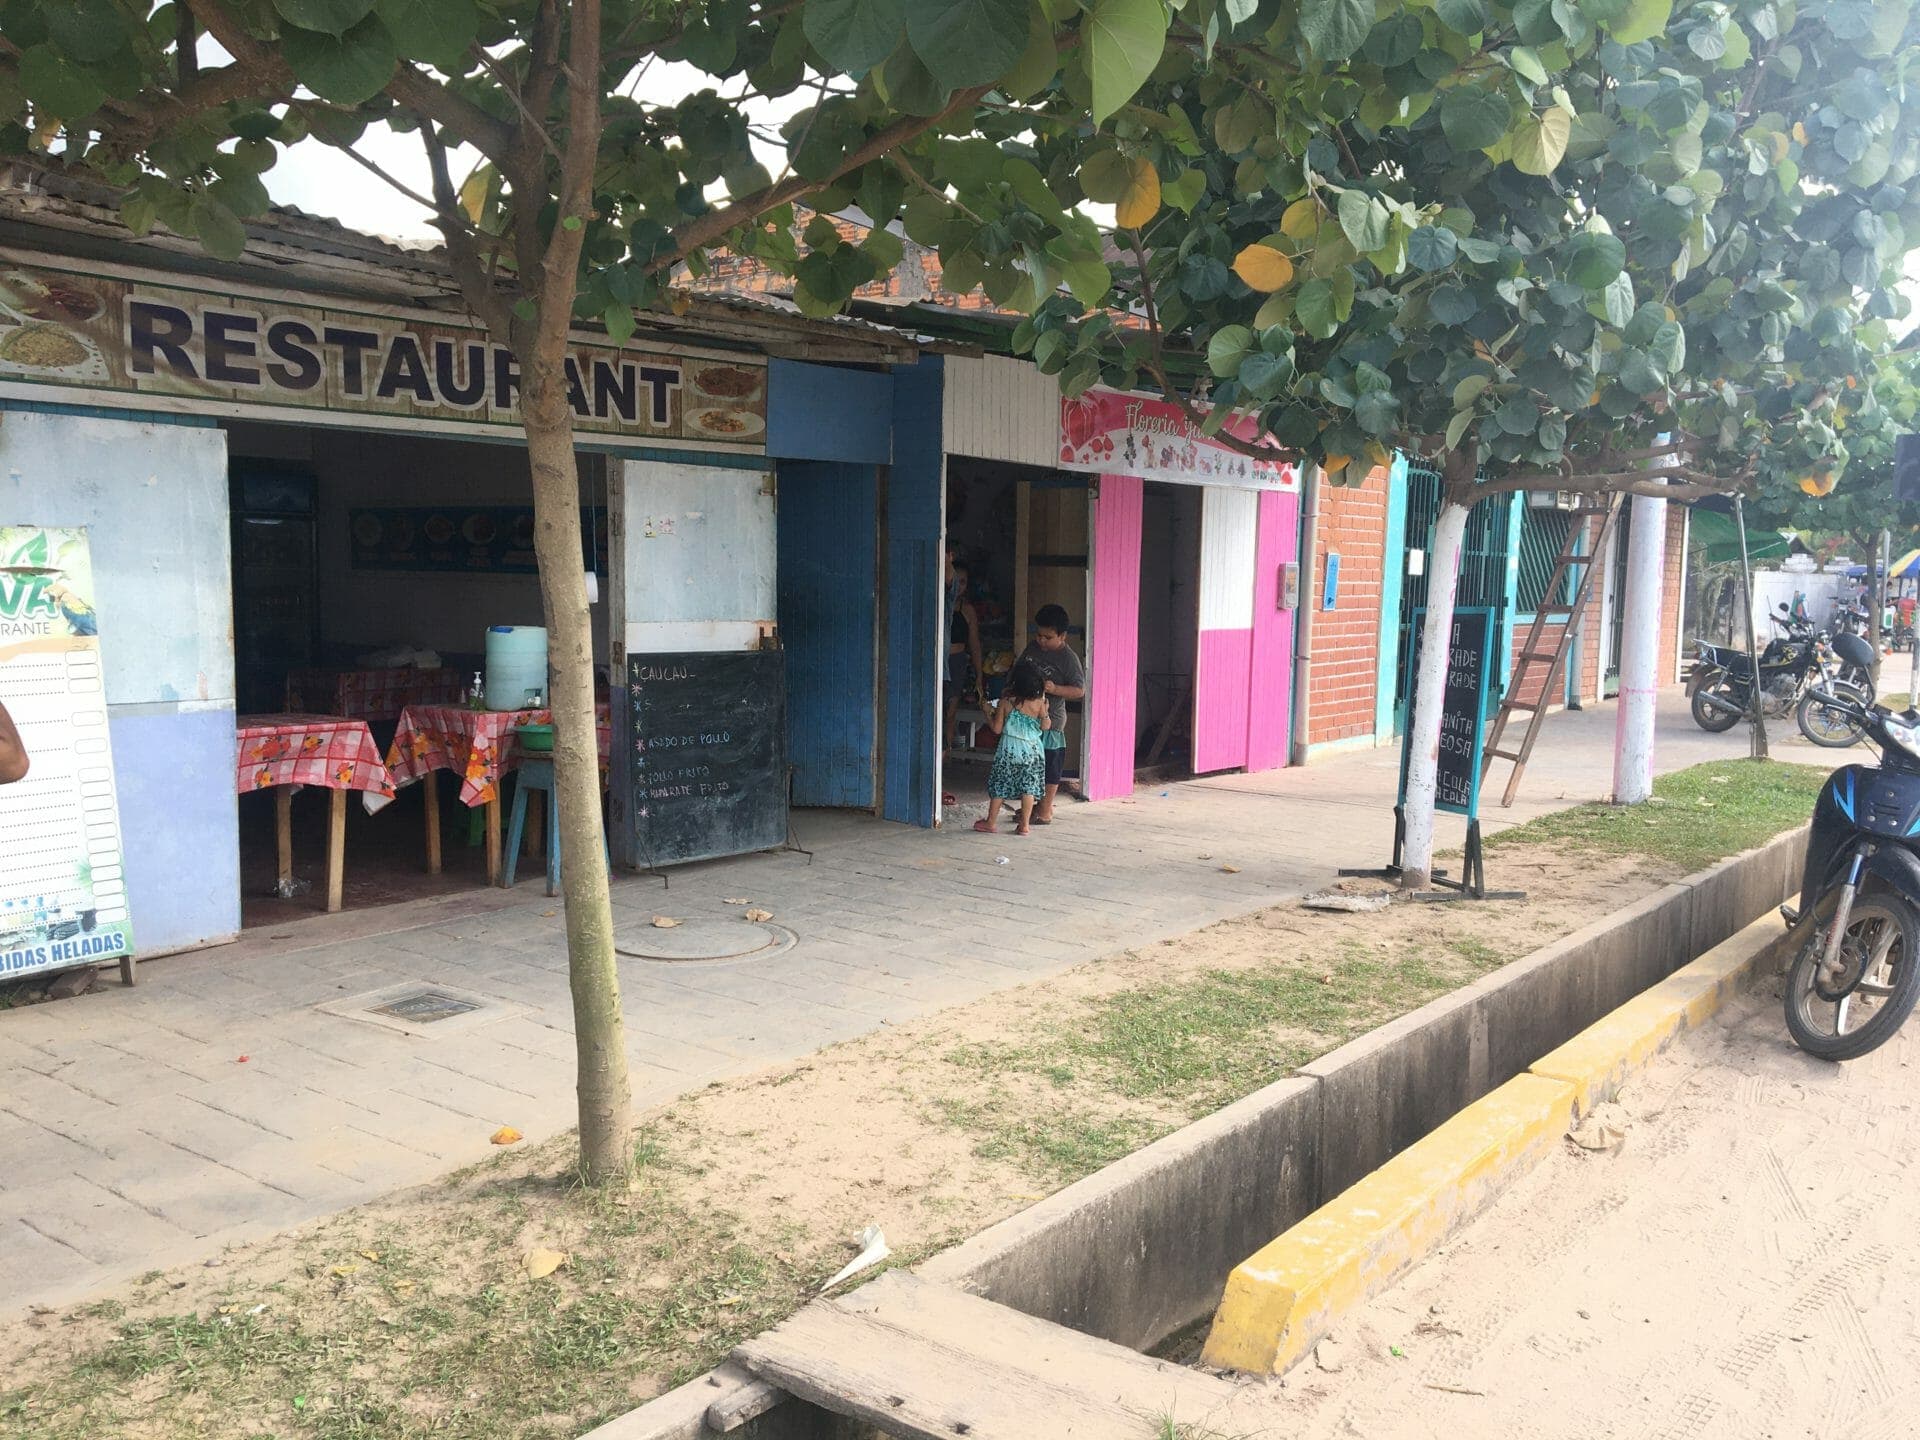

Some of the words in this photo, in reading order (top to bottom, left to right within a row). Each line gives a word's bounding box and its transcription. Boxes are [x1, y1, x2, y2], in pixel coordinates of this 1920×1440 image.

[681, 735, 696, 746] DE
[700, 731, 730, 745] POLLO
[51, 932, 125, 962] HELADAS
